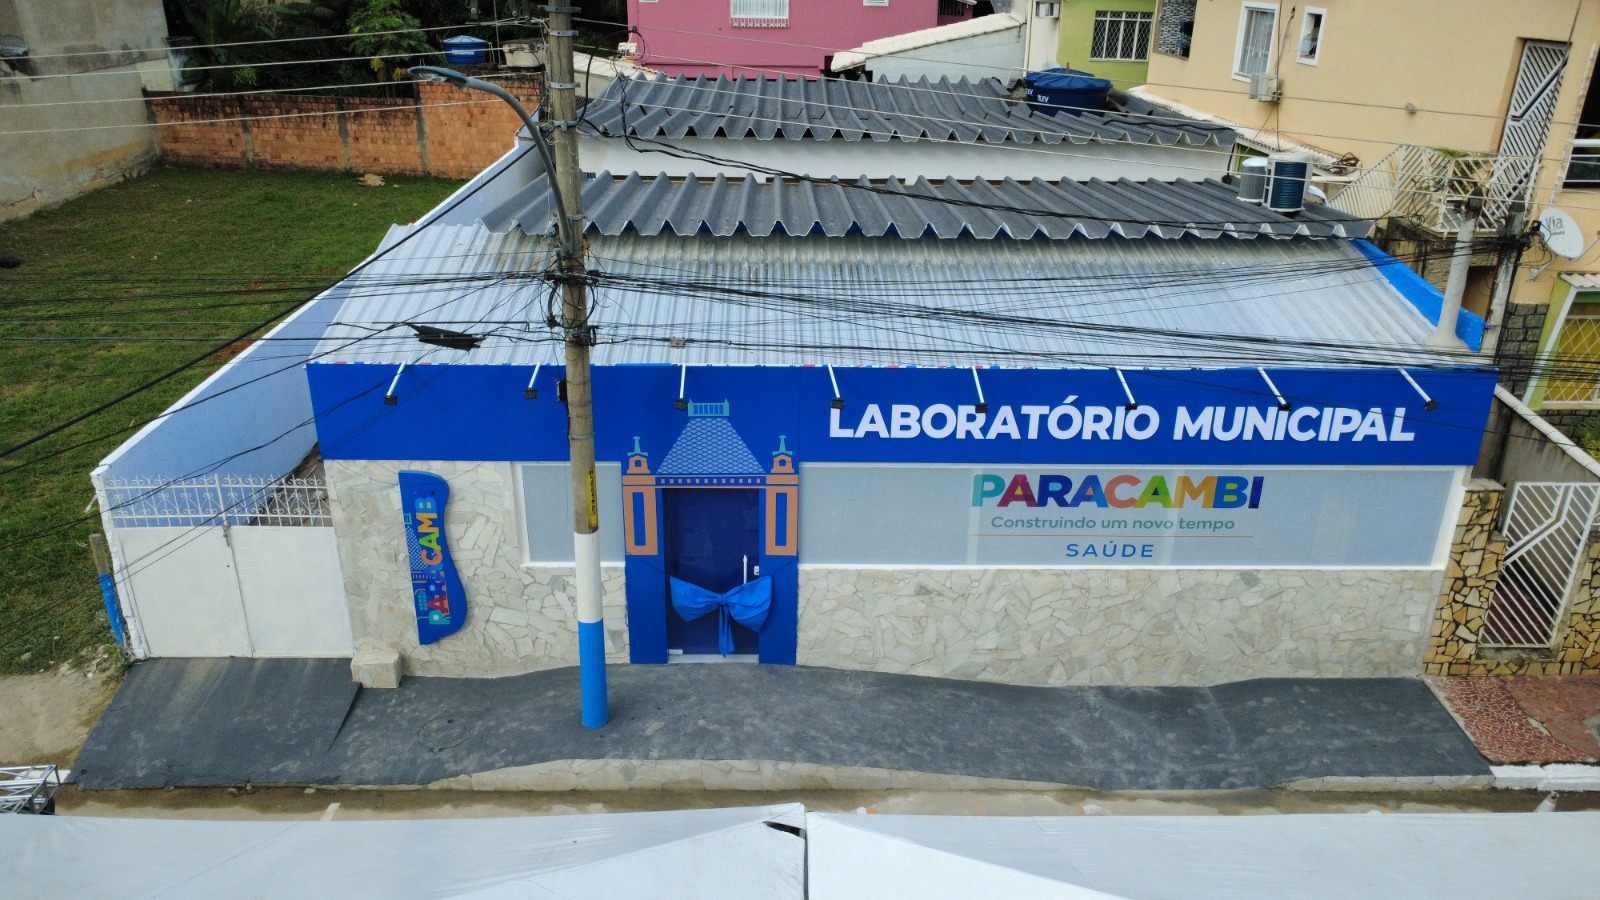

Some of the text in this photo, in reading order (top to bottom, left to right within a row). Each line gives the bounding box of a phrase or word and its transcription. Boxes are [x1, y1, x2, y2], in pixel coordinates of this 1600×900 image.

[829, 395, 1415, 442] LABORATÓRIO MUNICIPAL
[971, 474, 1264, 509] PARACAMBI
[991, 516, 1235, 532] Construindo um novo tempo
[1066, 540, 1154, 558] SAÚDE
